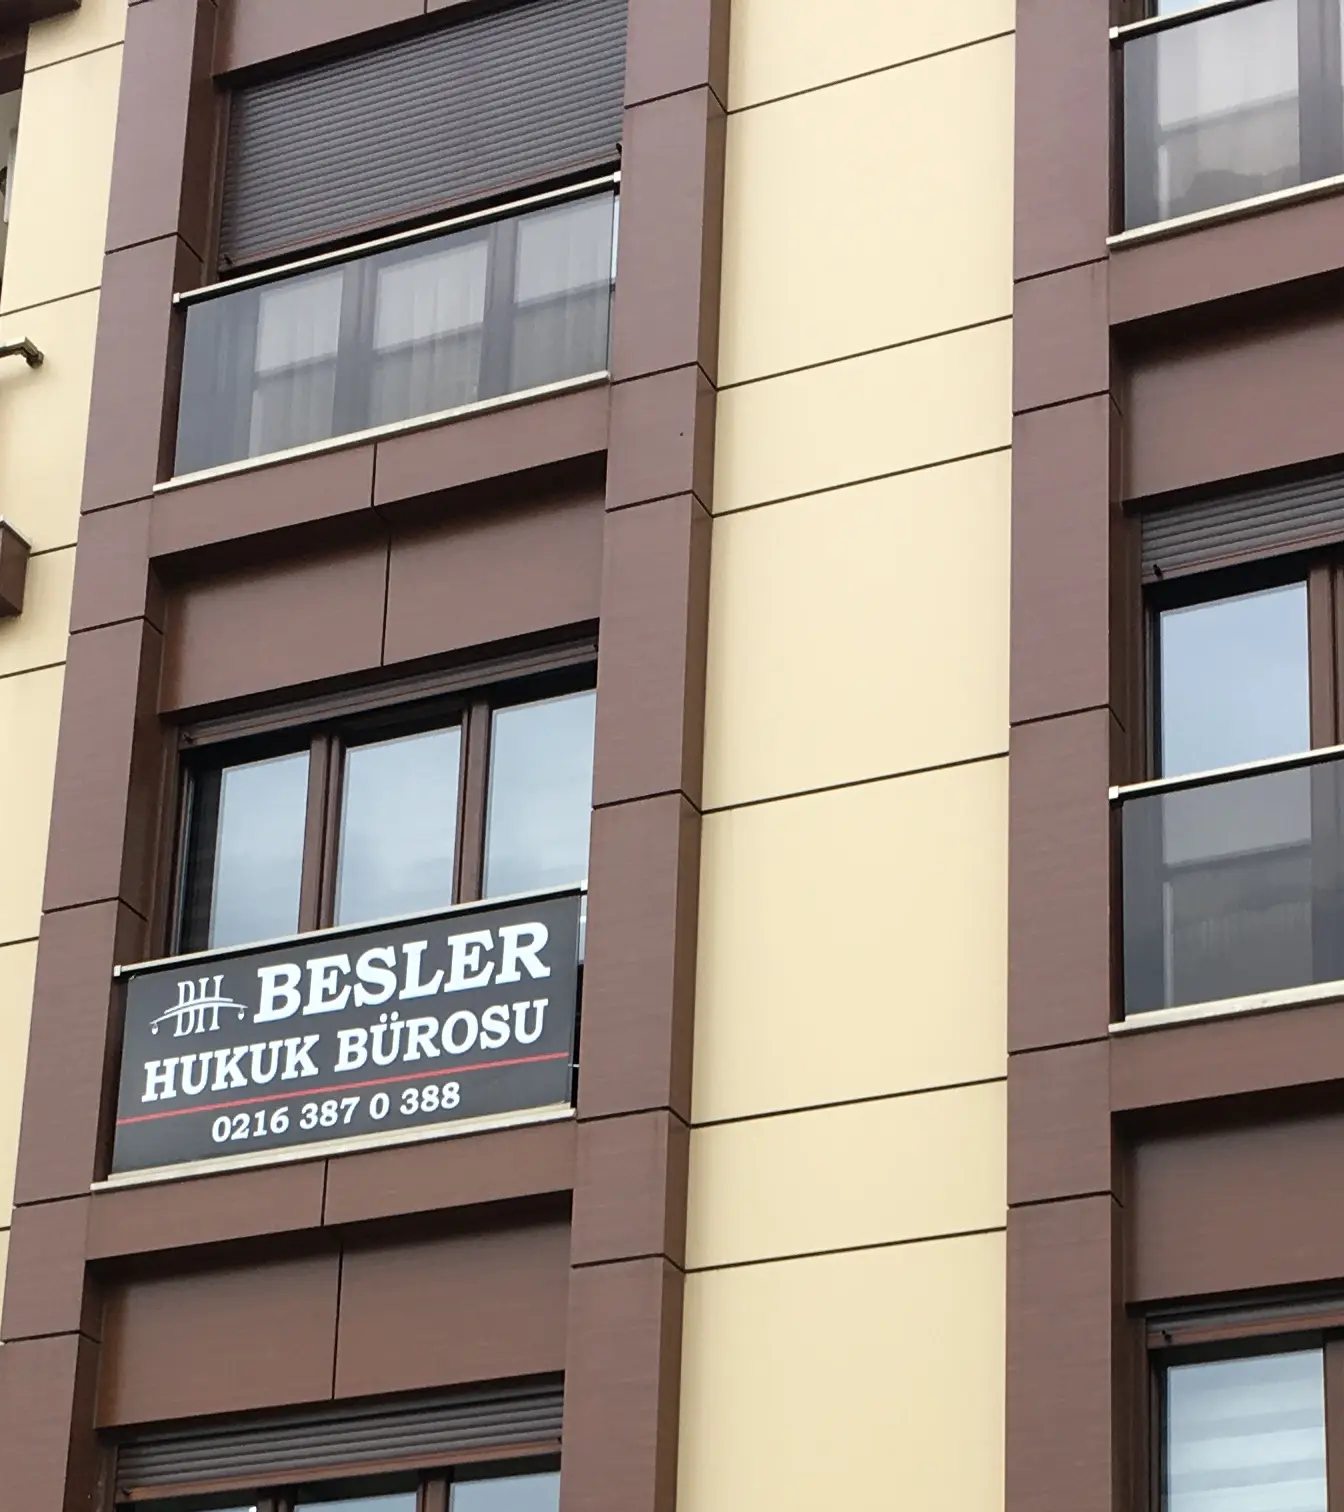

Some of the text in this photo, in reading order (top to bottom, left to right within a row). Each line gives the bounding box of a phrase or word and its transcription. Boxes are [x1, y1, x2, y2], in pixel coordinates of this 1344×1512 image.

[254, 921, 551, 1024] BESLER
[142, 998, 549, 1103] HUKUK BÜROSU
[211, 1081, 460, 1143] 0216 387 0 388
